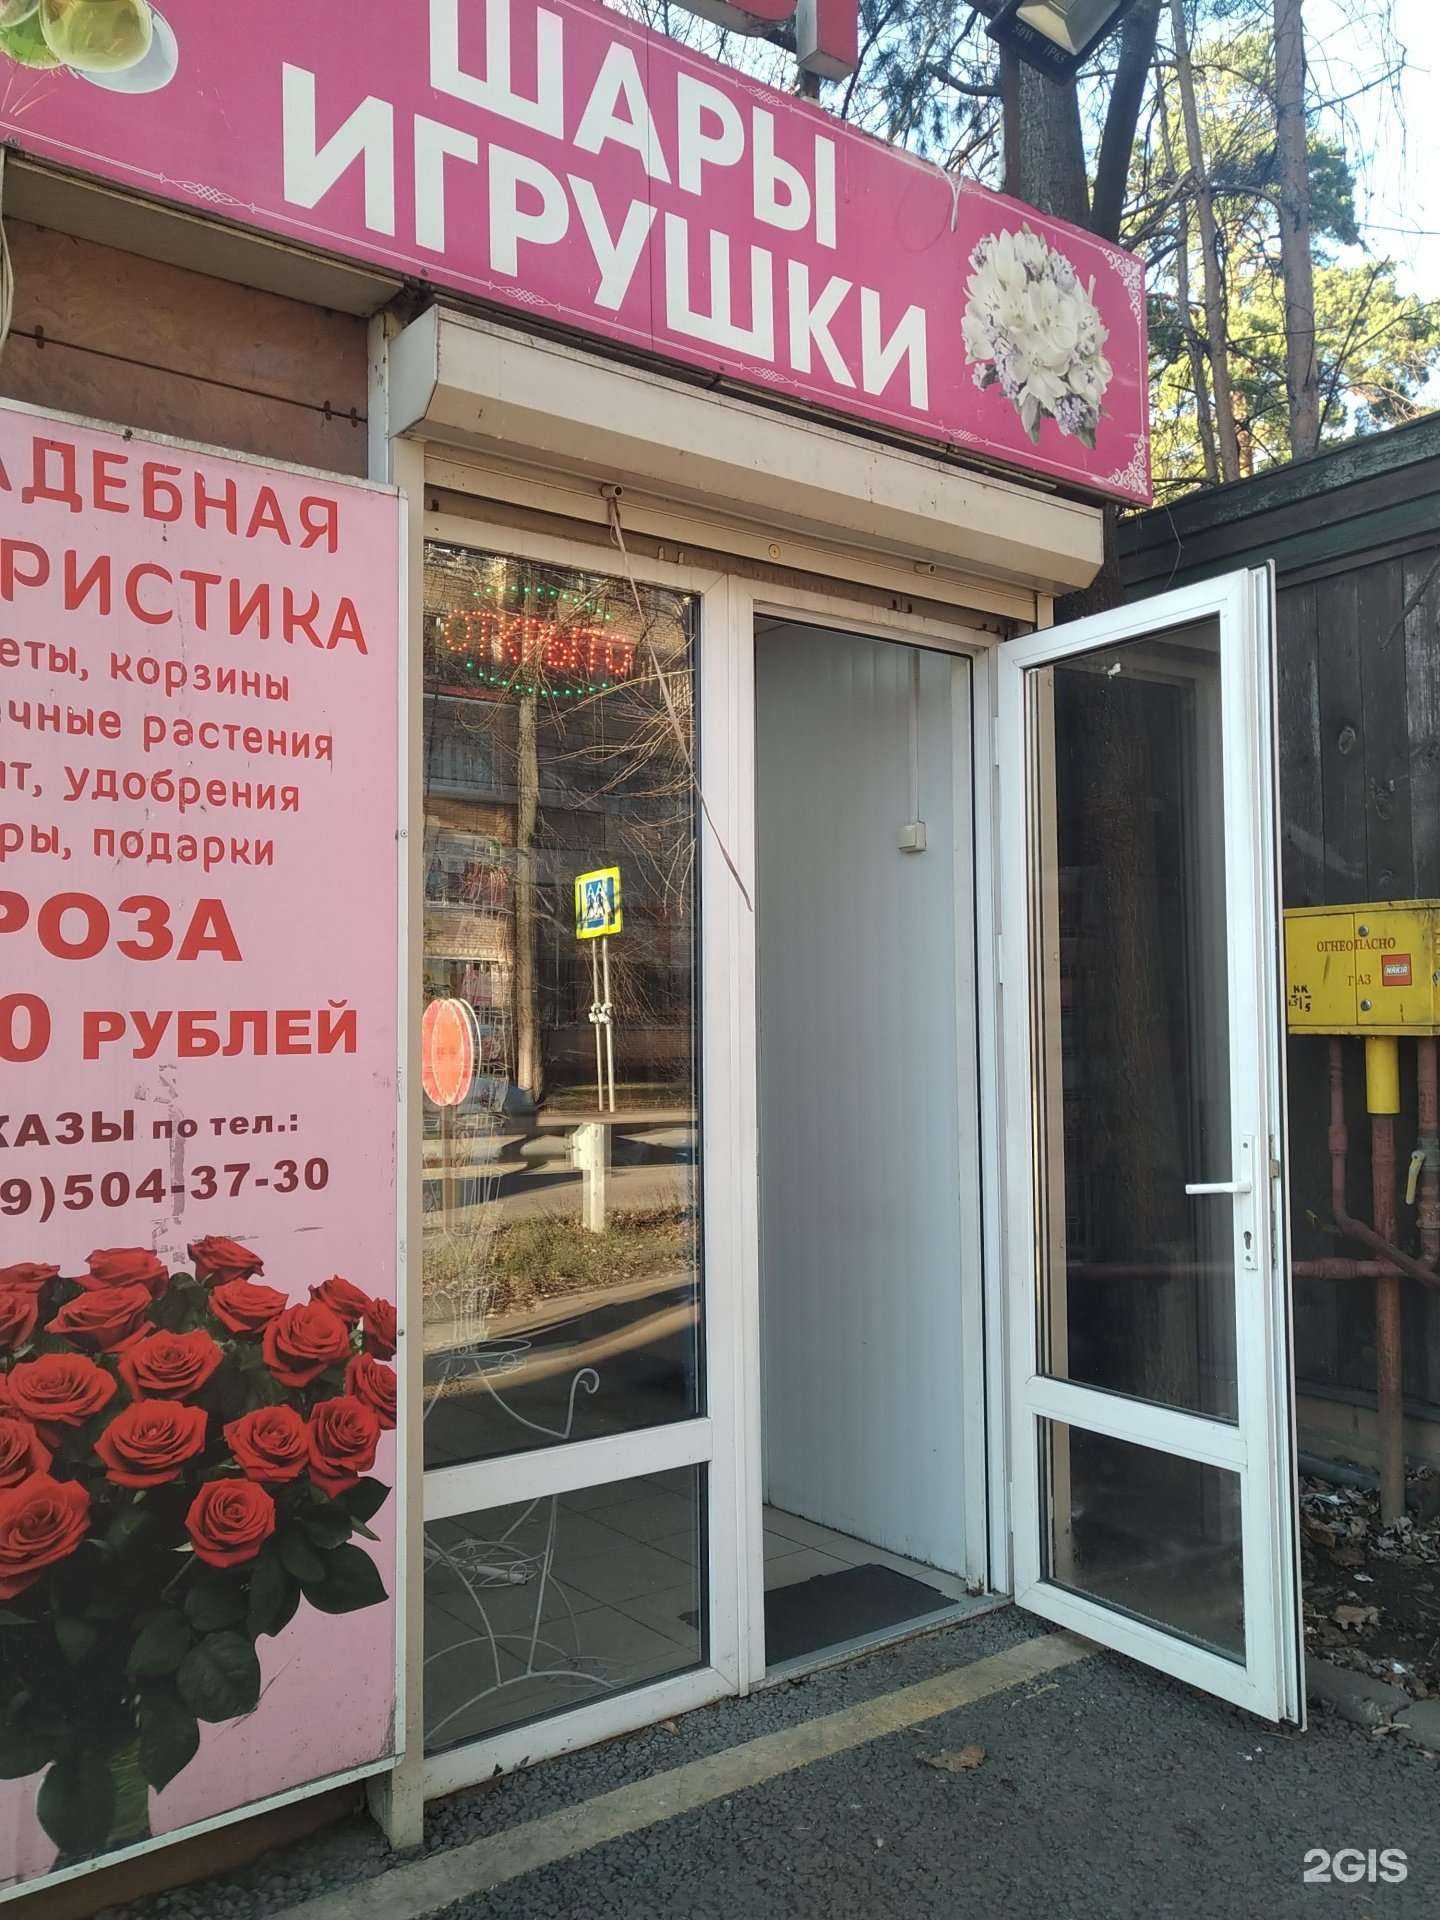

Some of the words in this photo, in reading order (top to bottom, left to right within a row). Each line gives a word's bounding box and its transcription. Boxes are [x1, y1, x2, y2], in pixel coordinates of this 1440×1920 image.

[429, 0, 837, 250] ШАРЫ
[282, 61, 929, 411] ИГРУШКИ
[0, 538, 369, 656] РИСТИКА
[0, 637, 89, 682] еты,
[110, 652, 290, 702] корзины
[443, 607, 632, 675] ОТКРЫТО
[0, 699, 122, 739] чные
[143, 714, 334, 761] растения
[63, 764, 300, 814] удобрения
[93, 828, 275, 874] подарки
[1316, 937, 1397, 953] ОГНЕОПАСНО
[1347, 974, 1372, 987] ГАЗ
[82, 999, 358, 1060] РУБЛЕЙ
[0, 1109, 135, 1148] АЗЫ
[152, 1118, 199, 1141] по
[209, 1113, 299, 1137] тел.:
[0, 1157, 330, 1223] 9)504-37-30
